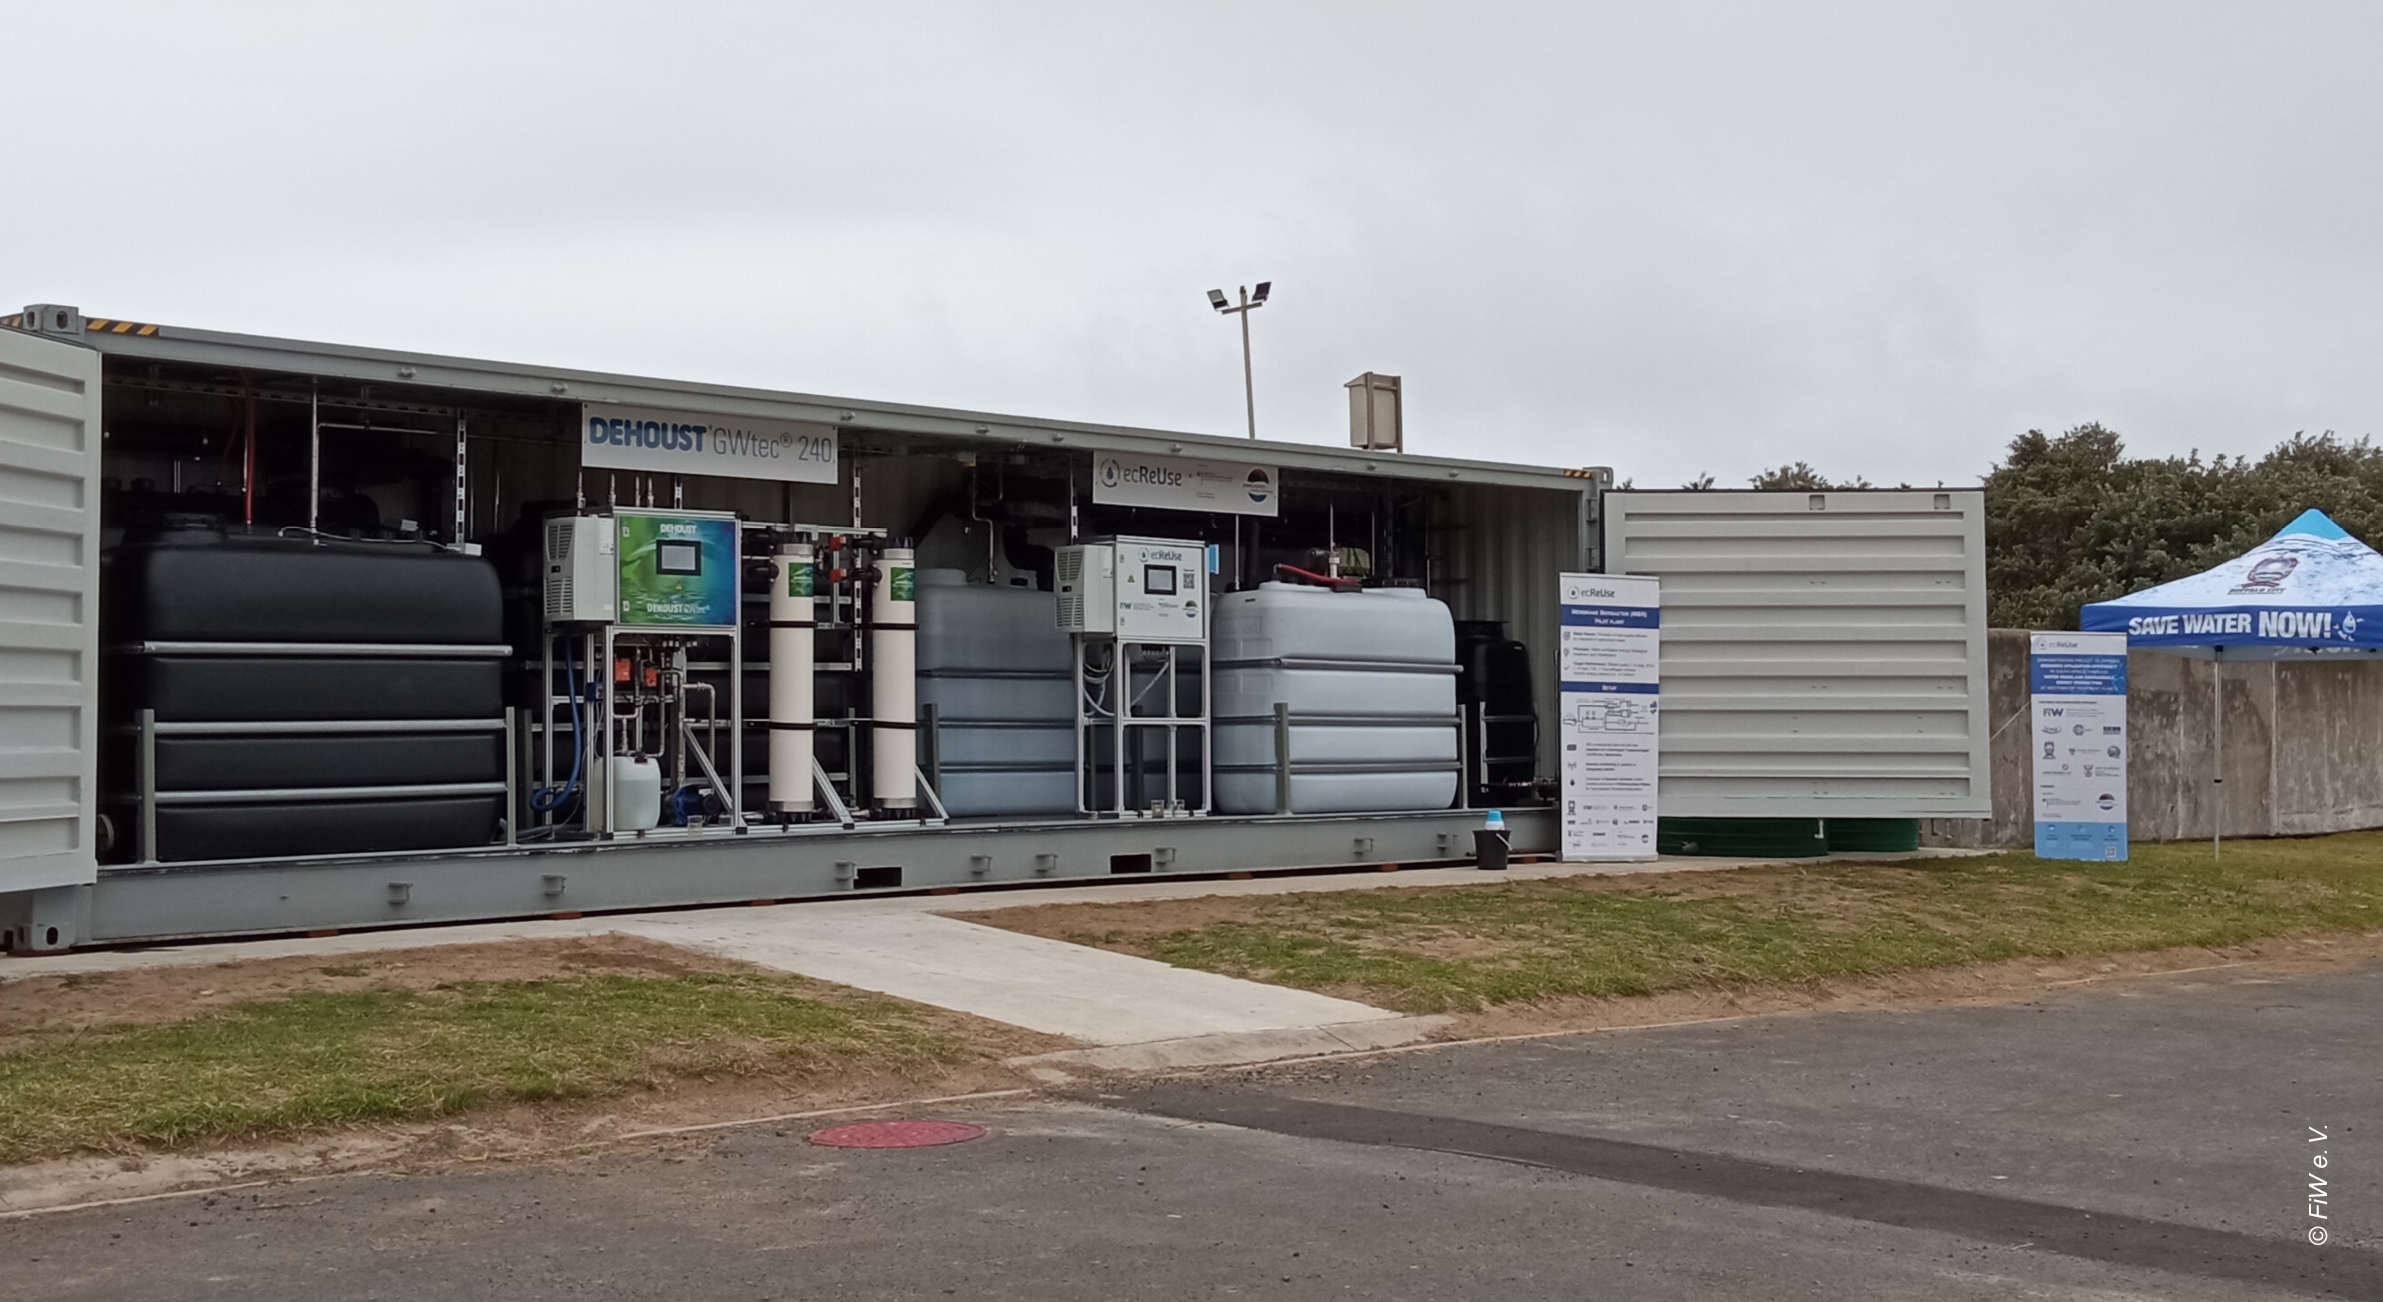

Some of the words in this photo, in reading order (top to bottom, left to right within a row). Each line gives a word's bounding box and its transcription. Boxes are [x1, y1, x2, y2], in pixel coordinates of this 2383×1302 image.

[589, 416, 707, 452] DEHOUST
[798, 435, 832, 463] 240
[1123, 465, 1182, 487] ecReUse
[660, 523, 698, 534] DEHOUST
[1150, 550, 1182, 562] ecReUse
[1581, 588, 1615, 598] ecReUse
[2128, 615, 2179, 635] SAVE
[2181, 612, 2252, 634] WATER
[2258, 611, 2332, 638] NOW!
